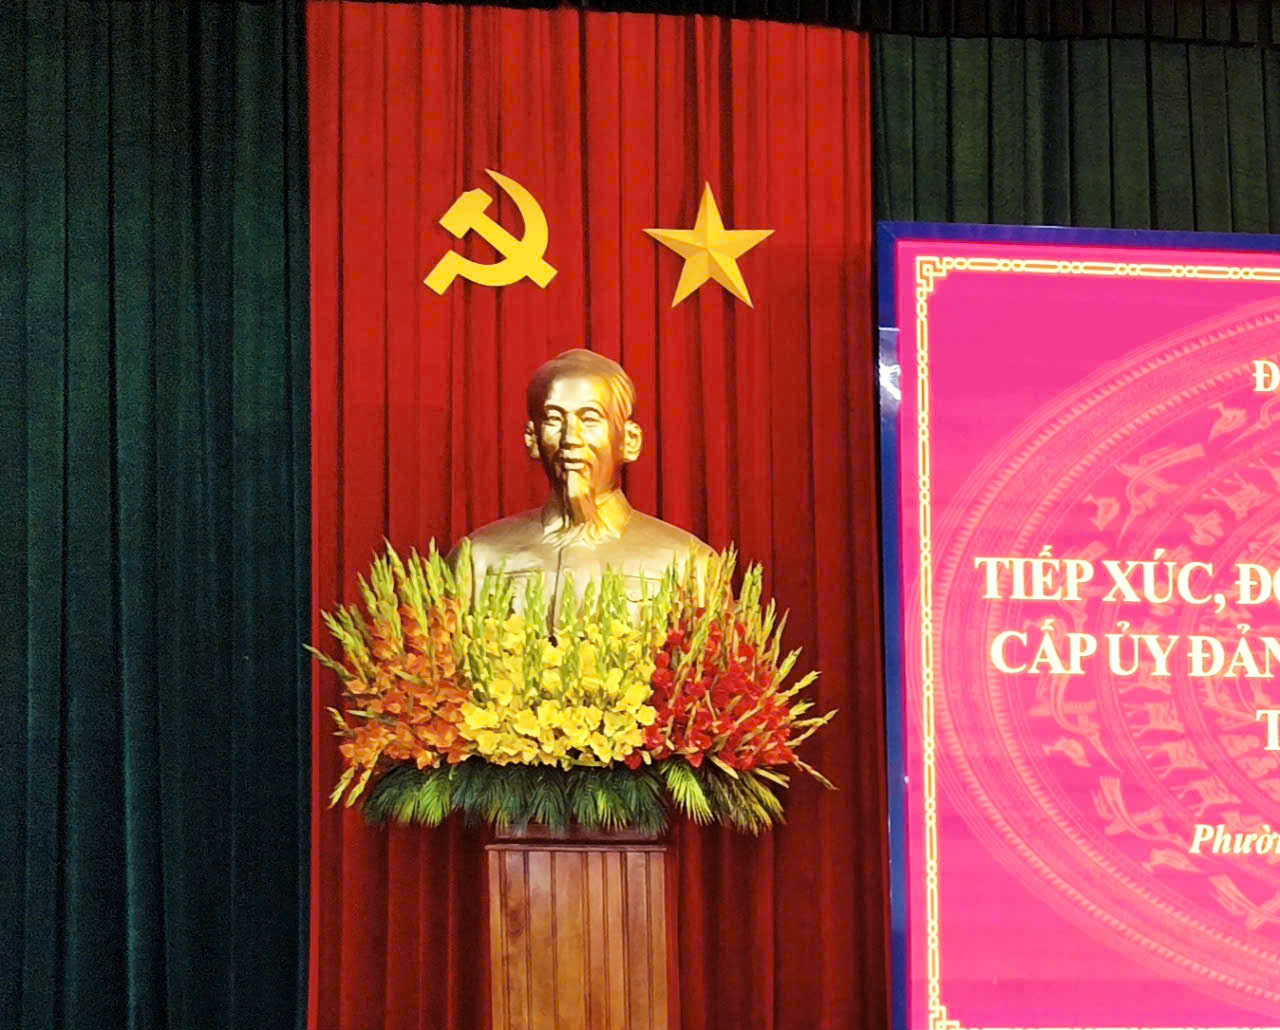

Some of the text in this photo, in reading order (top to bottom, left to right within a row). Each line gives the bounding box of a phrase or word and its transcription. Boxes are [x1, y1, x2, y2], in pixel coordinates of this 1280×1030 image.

[974, 545, 1093, 600] TIẾP
[1103, 549, 1225, 613] XÚC,
[990, 619, 1097, 674] CẤP
[1105, 621, 1179, 676] ỦY
